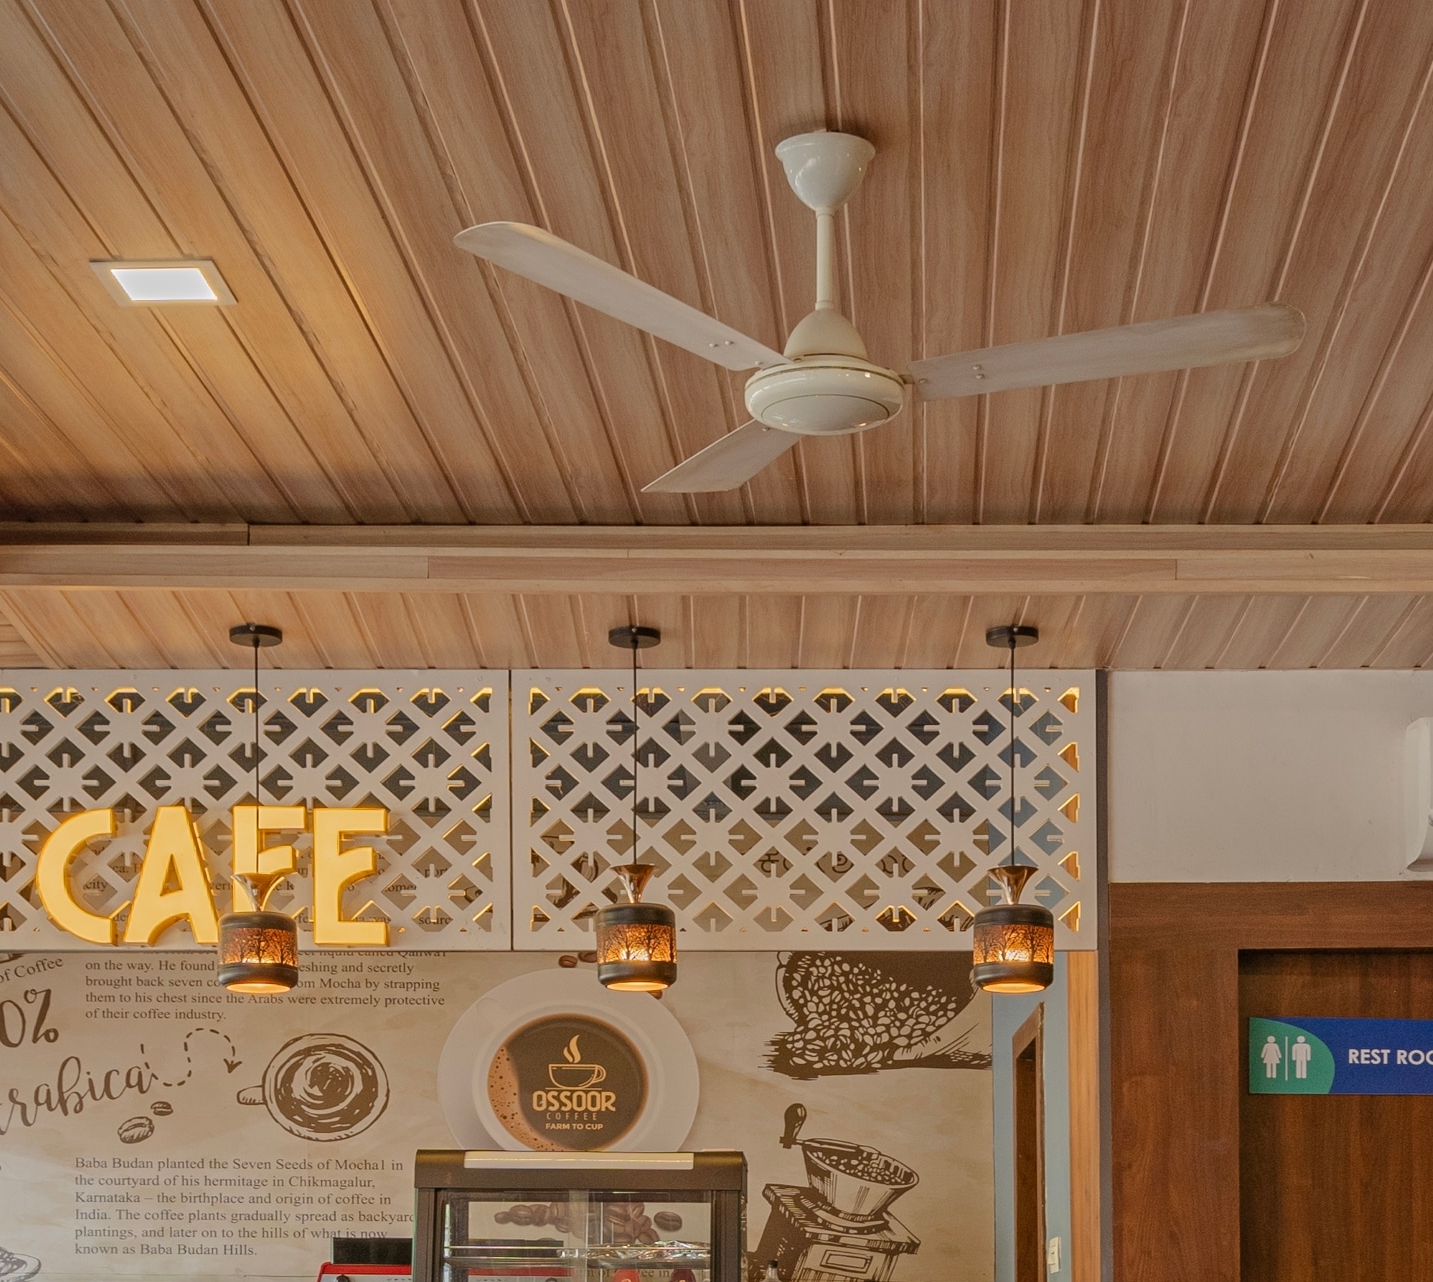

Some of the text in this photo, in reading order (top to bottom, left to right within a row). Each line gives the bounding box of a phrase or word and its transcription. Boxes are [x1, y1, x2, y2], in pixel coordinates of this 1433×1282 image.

[36, 805, 389, 946] CAFE
[13, 957, 65, 979] Coffee
[85, 960, 215, 973] on the way. He found
[341, 962, 364, 973] and
[367, 963, 414, 975] secretly
[85, 976, 132, 989] brought
[136, 976, 165, 987] back
[168, 979, 203, 987] seven
[319, 978, 362, 989] Mocha
[365, 978, 380, 991] by
[383, 980, 440, 992] strapping
[85, 992, 446, 1008] them to his chest since the Arabs were extremely protective
[85, 1008, 227, 1022] of their coffee industry.
[1348, 1048, 1391, 1065] REST
[532, 1090, 616, 1112] OSSOOR
[546, 1112, 598, 1121] COFFEE
[75, 1157, 108, 1169] Baba
[112, 1157, 154, 1169] Budan
[157, 1157, 205, 1171] planted
[209, 1158, 228, 1169] the
[232, 1158, 271, 1170] Seven
[275, 1158, 313, 1170] Seeds
[317, 1158, 332, 1170] of
[391, 1159, 403, 1171] in
[75, 1174, 375, 1190] the courtyard of his hermitage in Chikmagalur,
[75, 1191, 140, 1203] Karnataka
[157, 1192, 176, 1204] the
[180, 1192, 245, 1207] birthplace
[248, 1193, 271, 1205] and
[275, 1193, 314, 1207] origin
[317, 1193, 333, 1205] of
[335, 1193, 375, 1205] coffee
[379, 1193, 391, 1205] in
[75, 1209, 111, 1220] India.
[115, 1209, 140, 1220] The
[144, 1209, 184, 1221] coffee
[188, 1210, 226, 1224] plants
[230, 1210, 291, 1225] gradually
[295, 1210, 337, 1225] spread
[341, 1214, 354, 1222] as
[75, 1225, 387, 1240] plantings, and later on to the hills of what is now
[75, 1243, 257, 1256] known as Baba Budan Hills.
